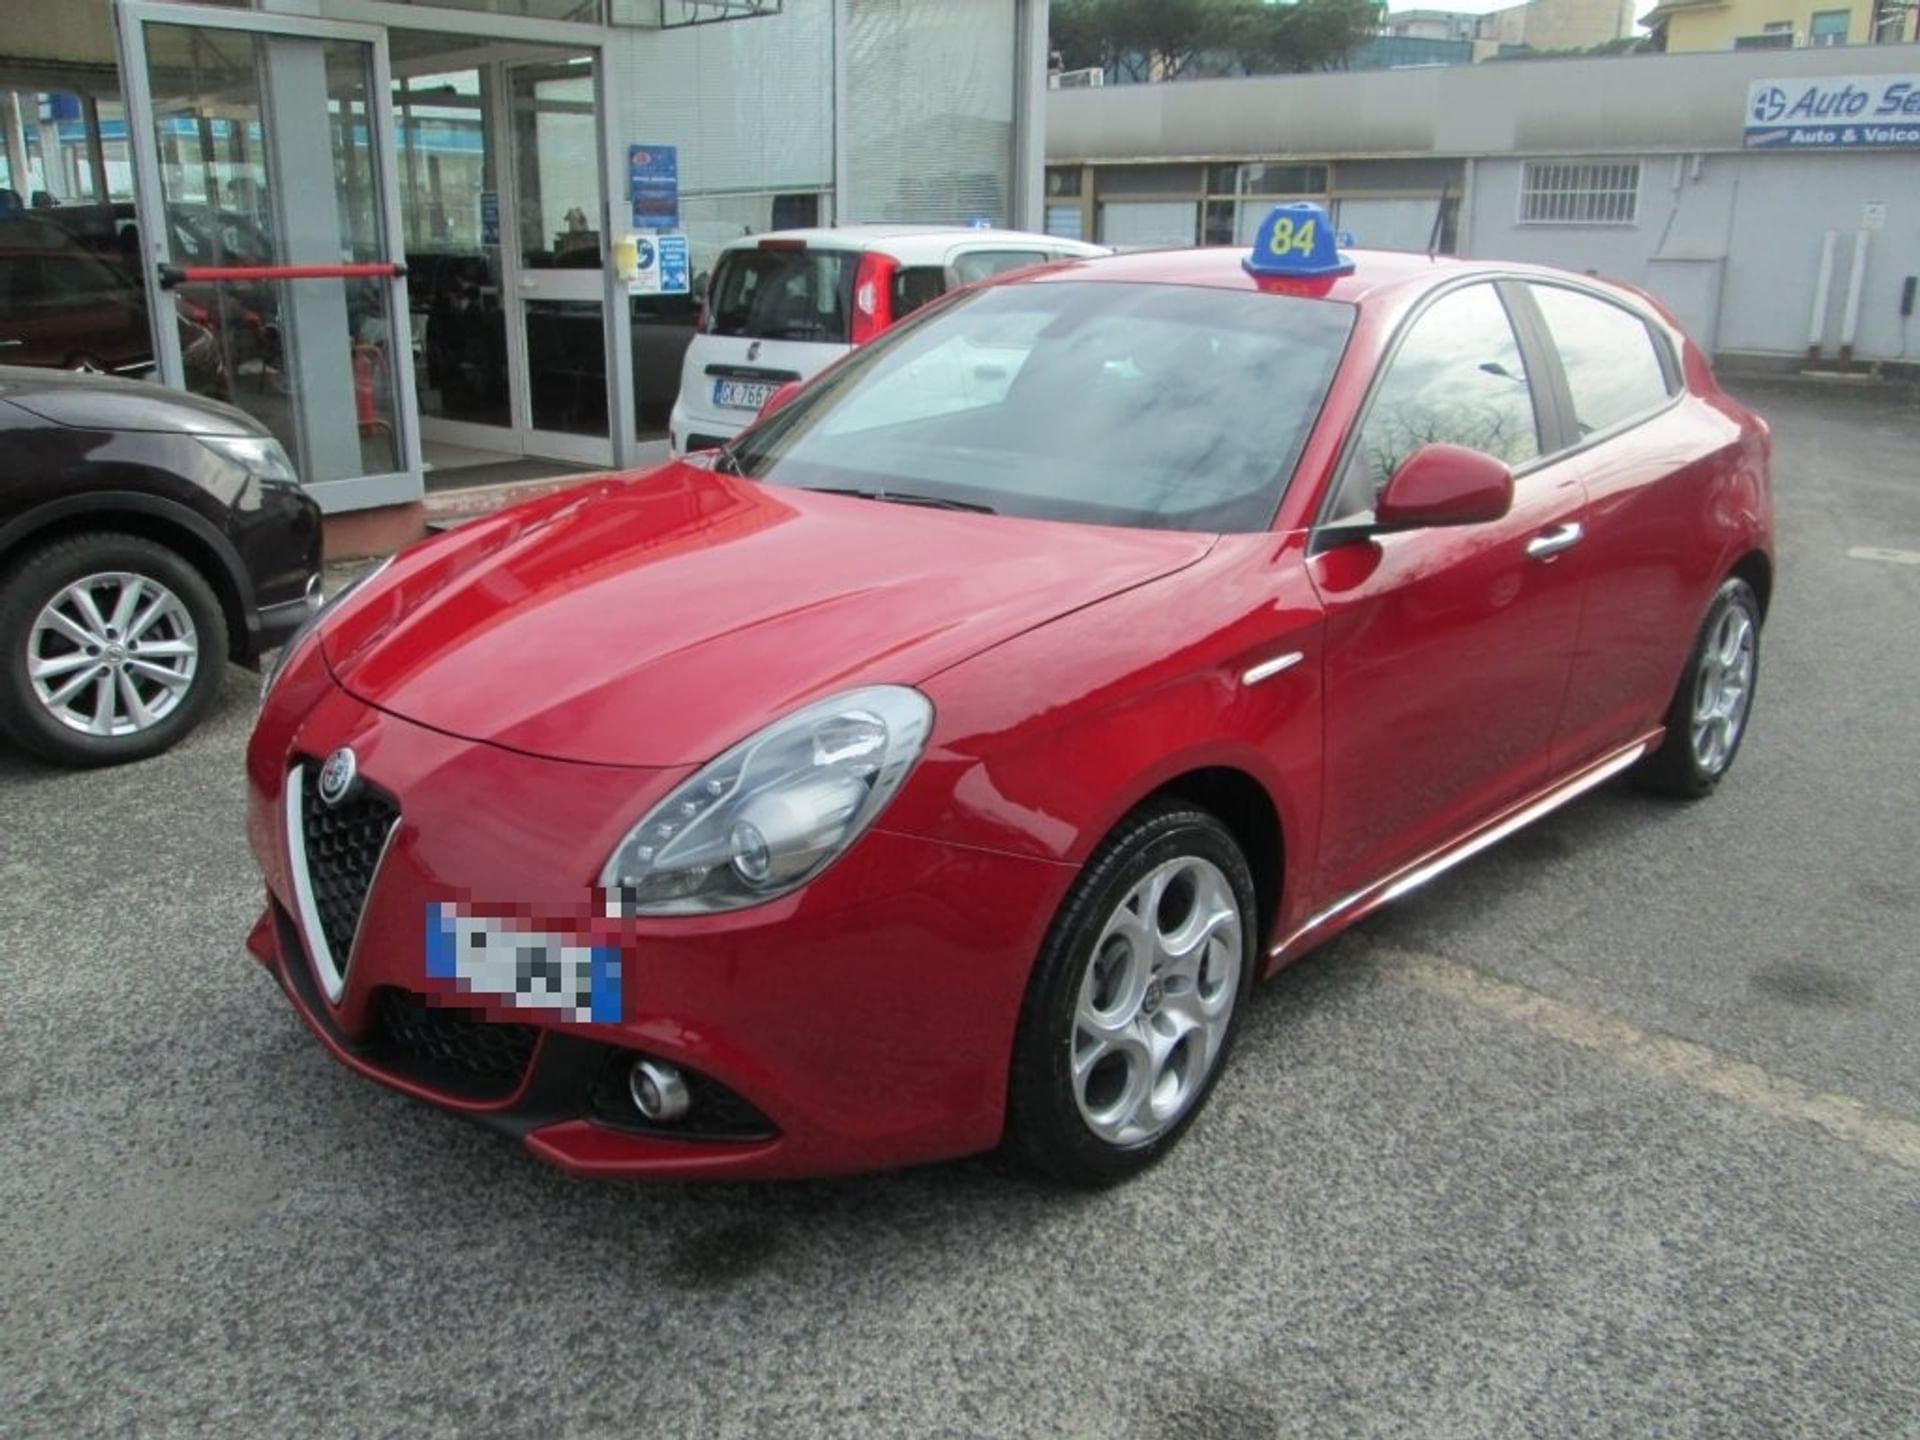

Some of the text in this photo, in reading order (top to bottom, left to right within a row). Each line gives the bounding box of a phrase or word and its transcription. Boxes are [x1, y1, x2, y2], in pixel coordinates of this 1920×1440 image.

[1787, 84, 1869, 118] Auto
[1790, 128, 1835, 143] Auto
[1842, 128, 1857, 143] &
[1270, 217, 1316, 257] 84
